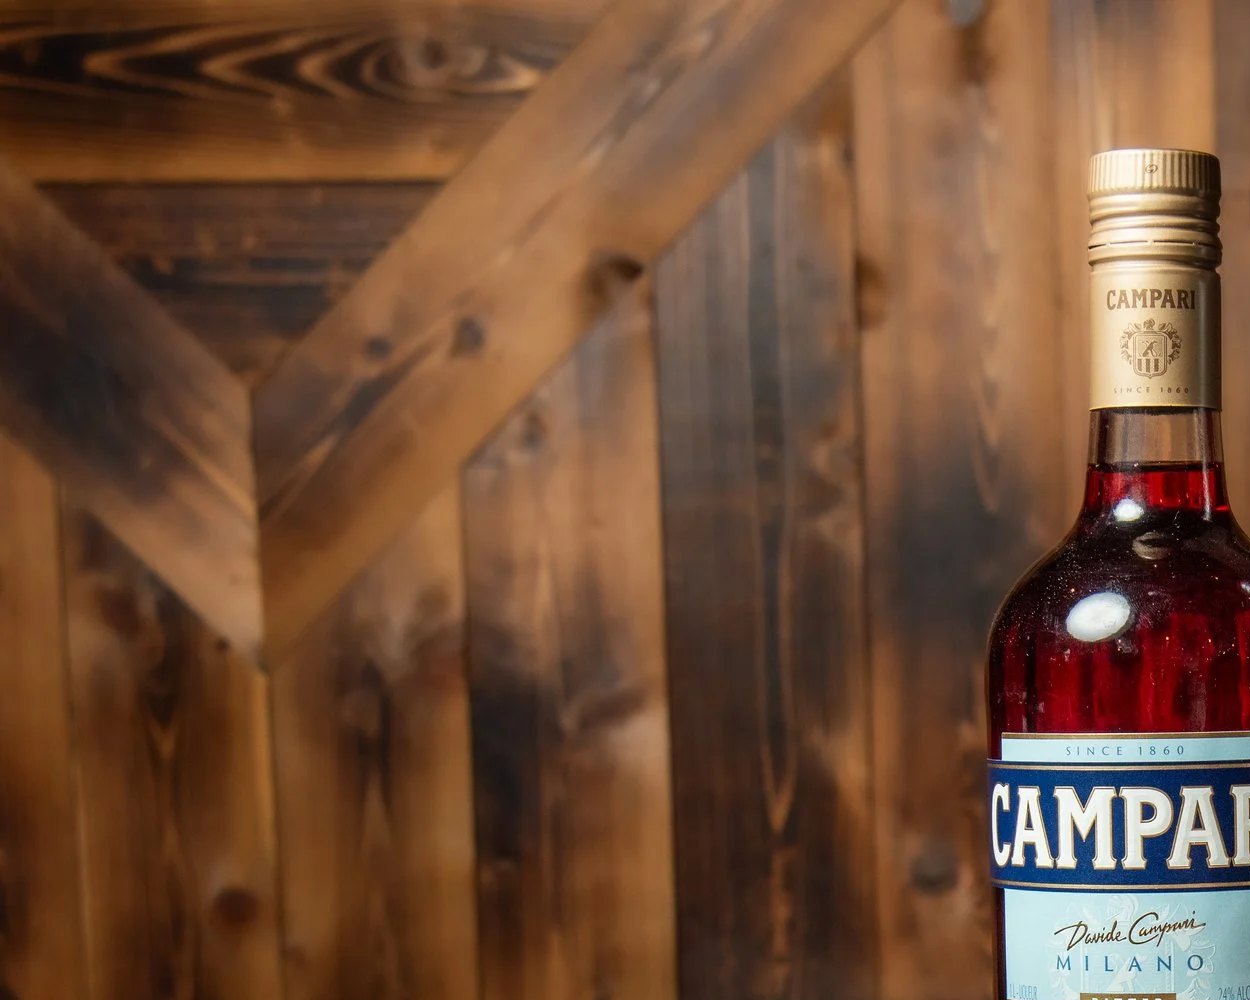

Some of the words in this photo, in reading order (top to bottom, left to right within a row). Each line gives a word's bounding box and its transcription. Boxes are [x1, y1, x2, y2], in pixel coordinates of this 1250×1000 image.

[1106, 288, 1196, 311] CAMPARI
[1113, 386, 1150, 394] SINCE
[1160, 386, 1189, 394] 1860
[1065, 744, 1124, 757] SINCE
[1137, 744, 1186, 756] 1860
[1054, 920, 1127, 951] Davide
[1128, 910, 1207, 947] Campari
[1056, 954, 1204, 972] MILANO
